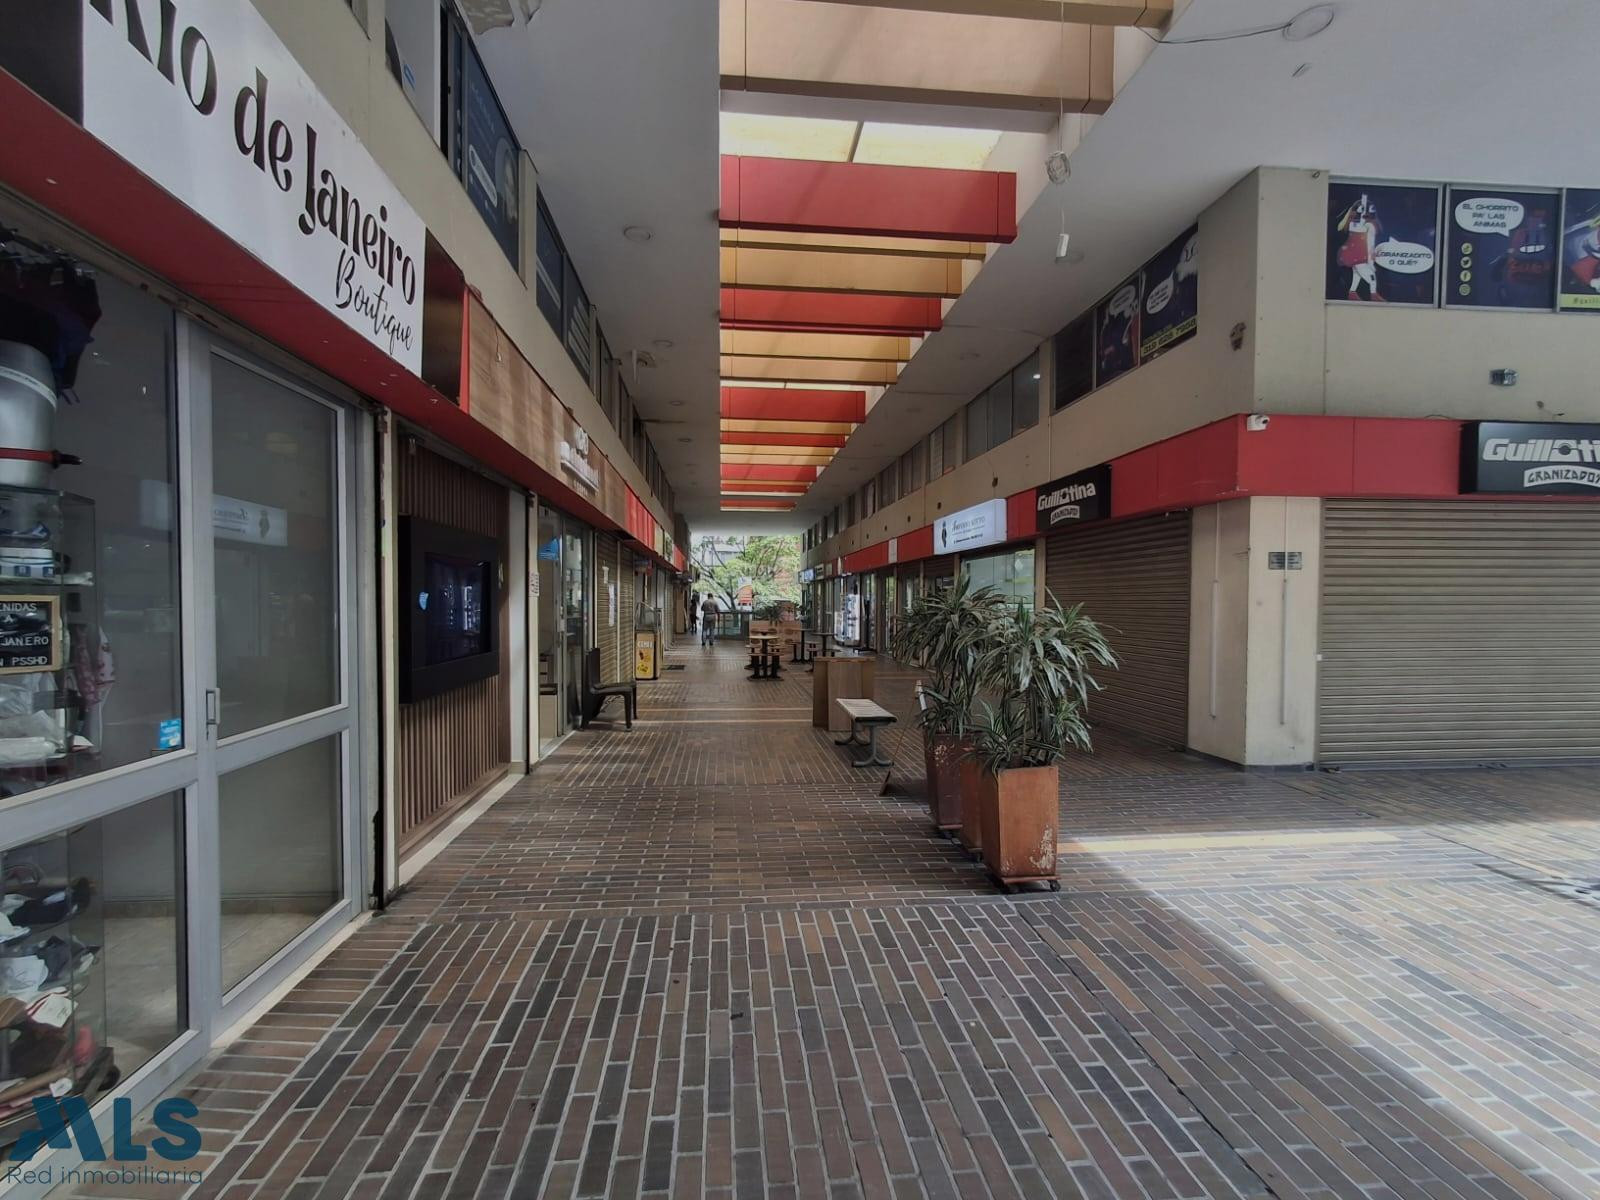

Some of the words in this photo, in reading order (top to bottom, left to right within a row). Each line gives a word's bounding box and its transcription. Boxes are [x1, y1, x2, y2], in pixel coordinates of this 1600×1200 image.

[234, 66, 293, 192] de
[299, 122, 416, 306] Janeiro
[1475, 203, 1519, 212] CHORRITO
[1472, 220, 1506, 228] ANIMAS
[335, 248, 414, 356] Boutique
